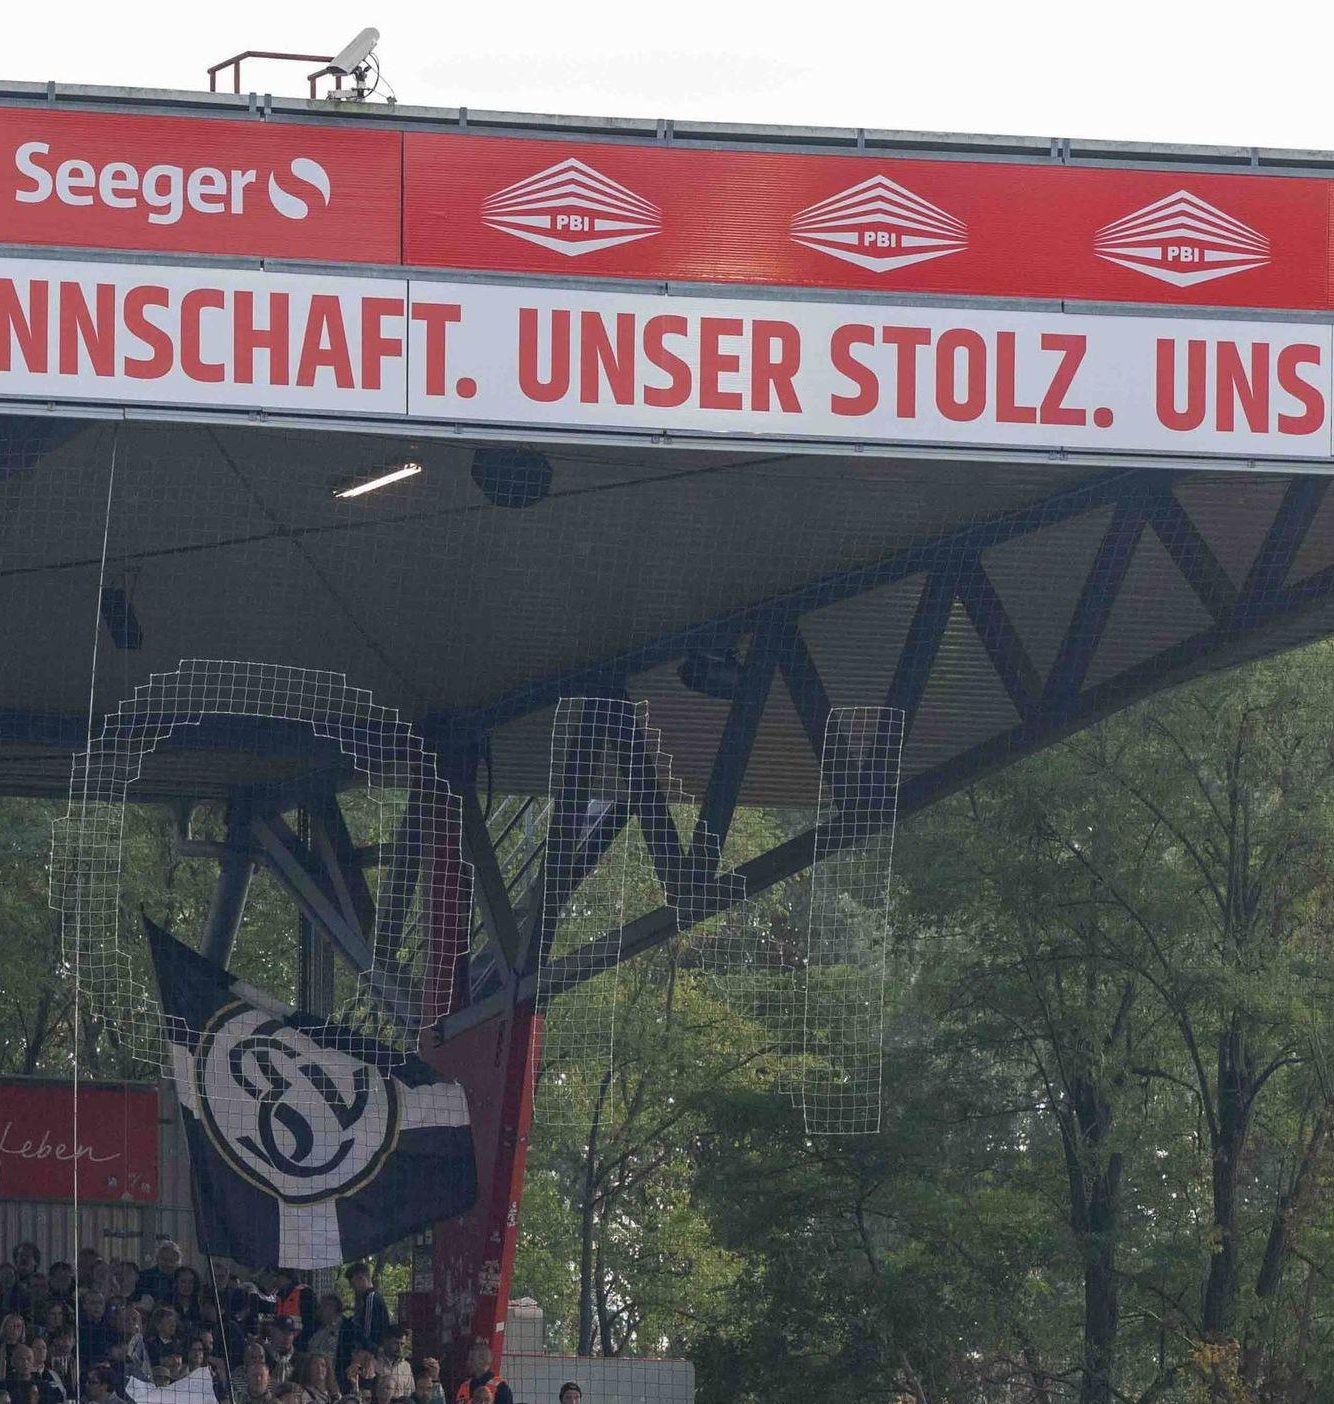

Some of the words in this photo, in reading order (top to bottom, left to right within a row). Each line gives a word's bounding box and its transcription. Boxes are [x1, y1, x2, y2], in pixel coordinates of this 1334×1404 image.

[14, 141, 257, 225] Seeger
[556, 214, 590, 233] PBI
[863, 230, 898, 249] PBI
[1166, 245, 1200, 264] PBI
[517, 307, 803, 414] UNSER
[829, 323, 1115, 429] STOLZ.
